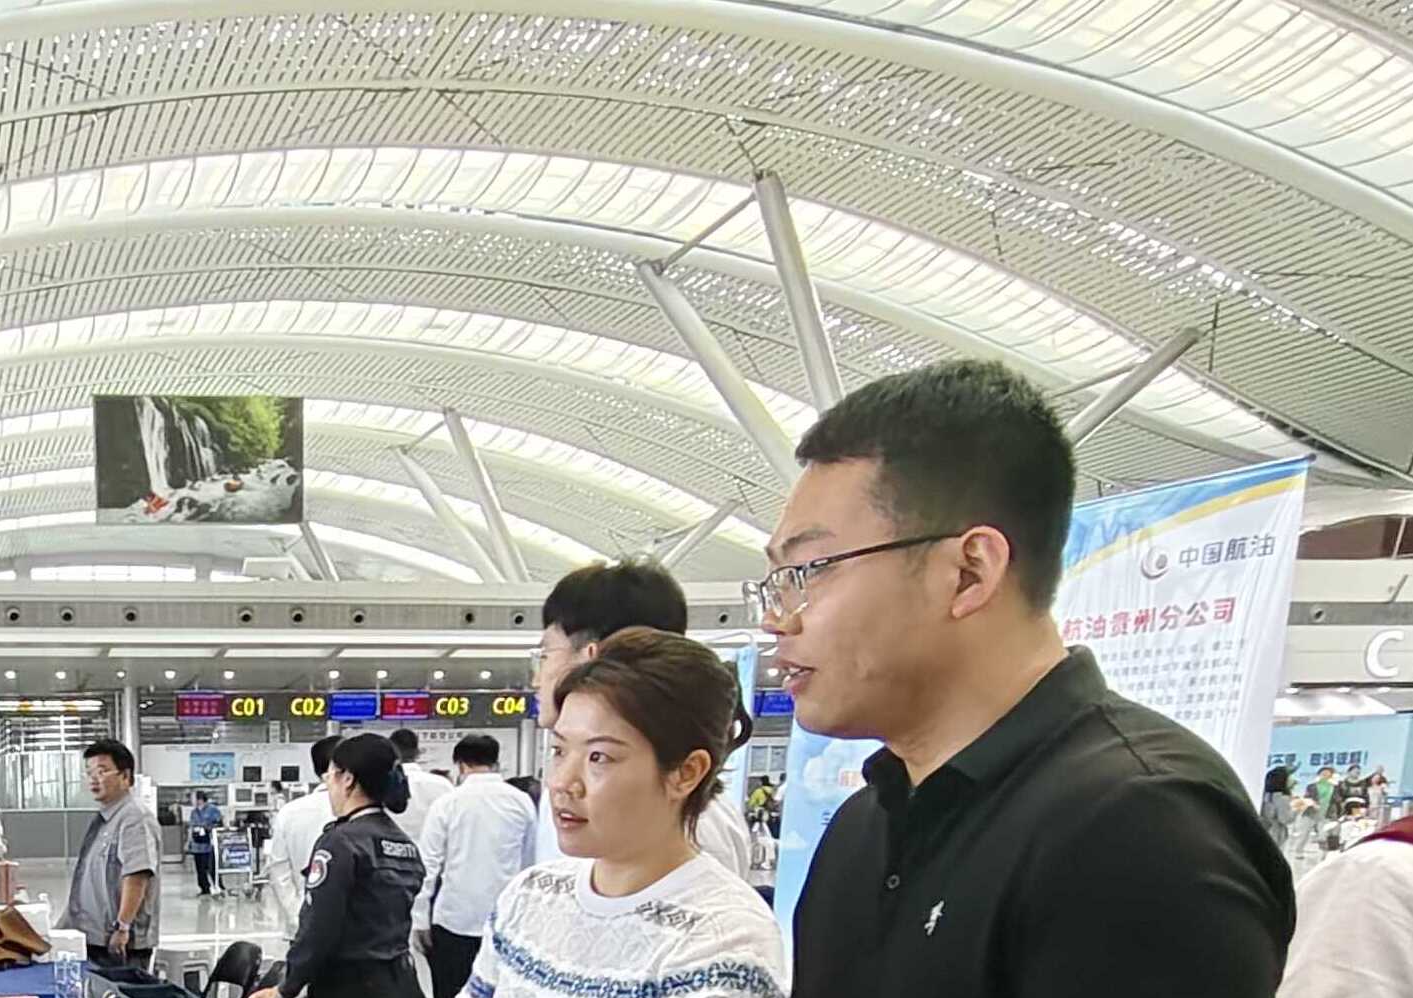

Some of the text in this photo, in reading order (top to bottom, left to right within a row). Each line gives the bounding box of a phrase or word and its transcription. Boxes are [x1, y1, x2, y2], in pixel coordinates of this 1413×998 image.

[1179, 533, 1276, 568] 中国航油
[1062, 597, 1237, 641] 航油贵州分公司
[1366, 629, 1405, 678] C
[231, 698, 264, 716] C01
[290, 698, 326, 716] C02
[436, 697, 470, 715] C03
[493, 697, 526, 714] C04
